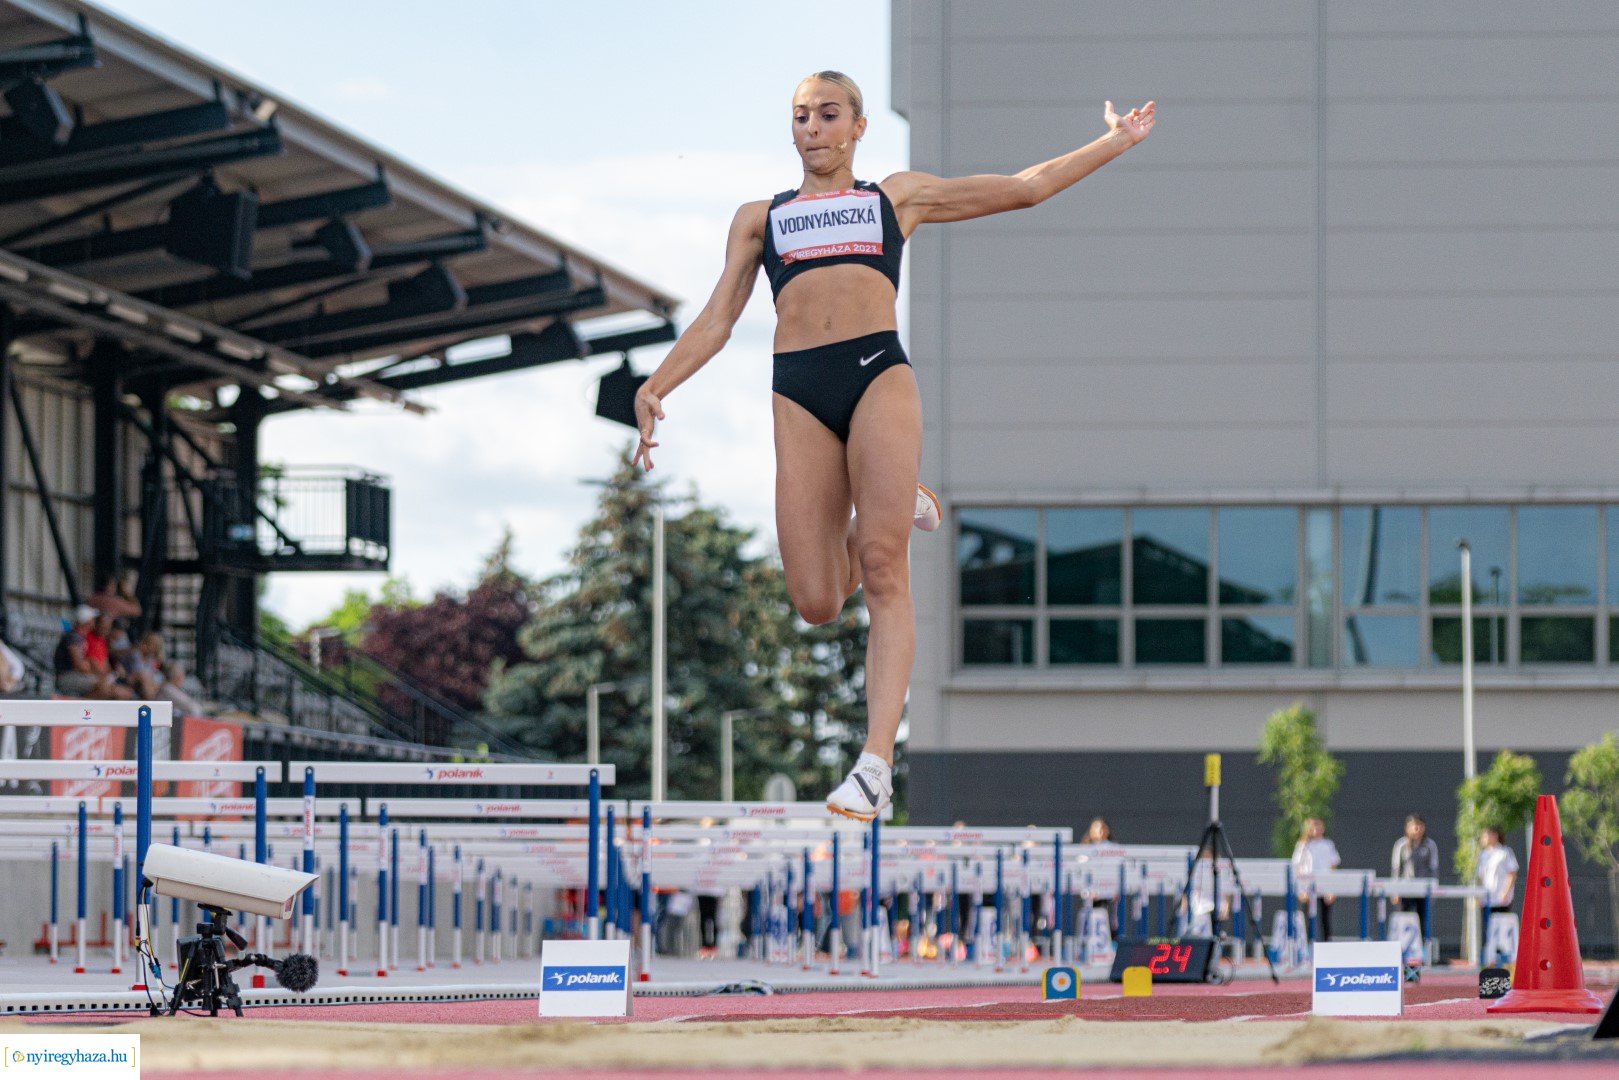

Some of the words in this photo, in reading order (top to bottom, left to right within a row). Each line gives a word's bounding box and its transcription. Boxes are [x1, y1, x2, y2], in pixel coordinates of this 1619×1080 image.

[778, 205, 876, 235] VODNYÁNSZKÁ
[788, 244, 852, 260] YÍREGYHÁZA
[853, 243, 878, 253] 2023
[437, 767, 484, 780] polanik
[486, 803, 522, 814] polanik
[567, 972, 620, 986] polanik
[1340, 973, 1394, 987] polanik
